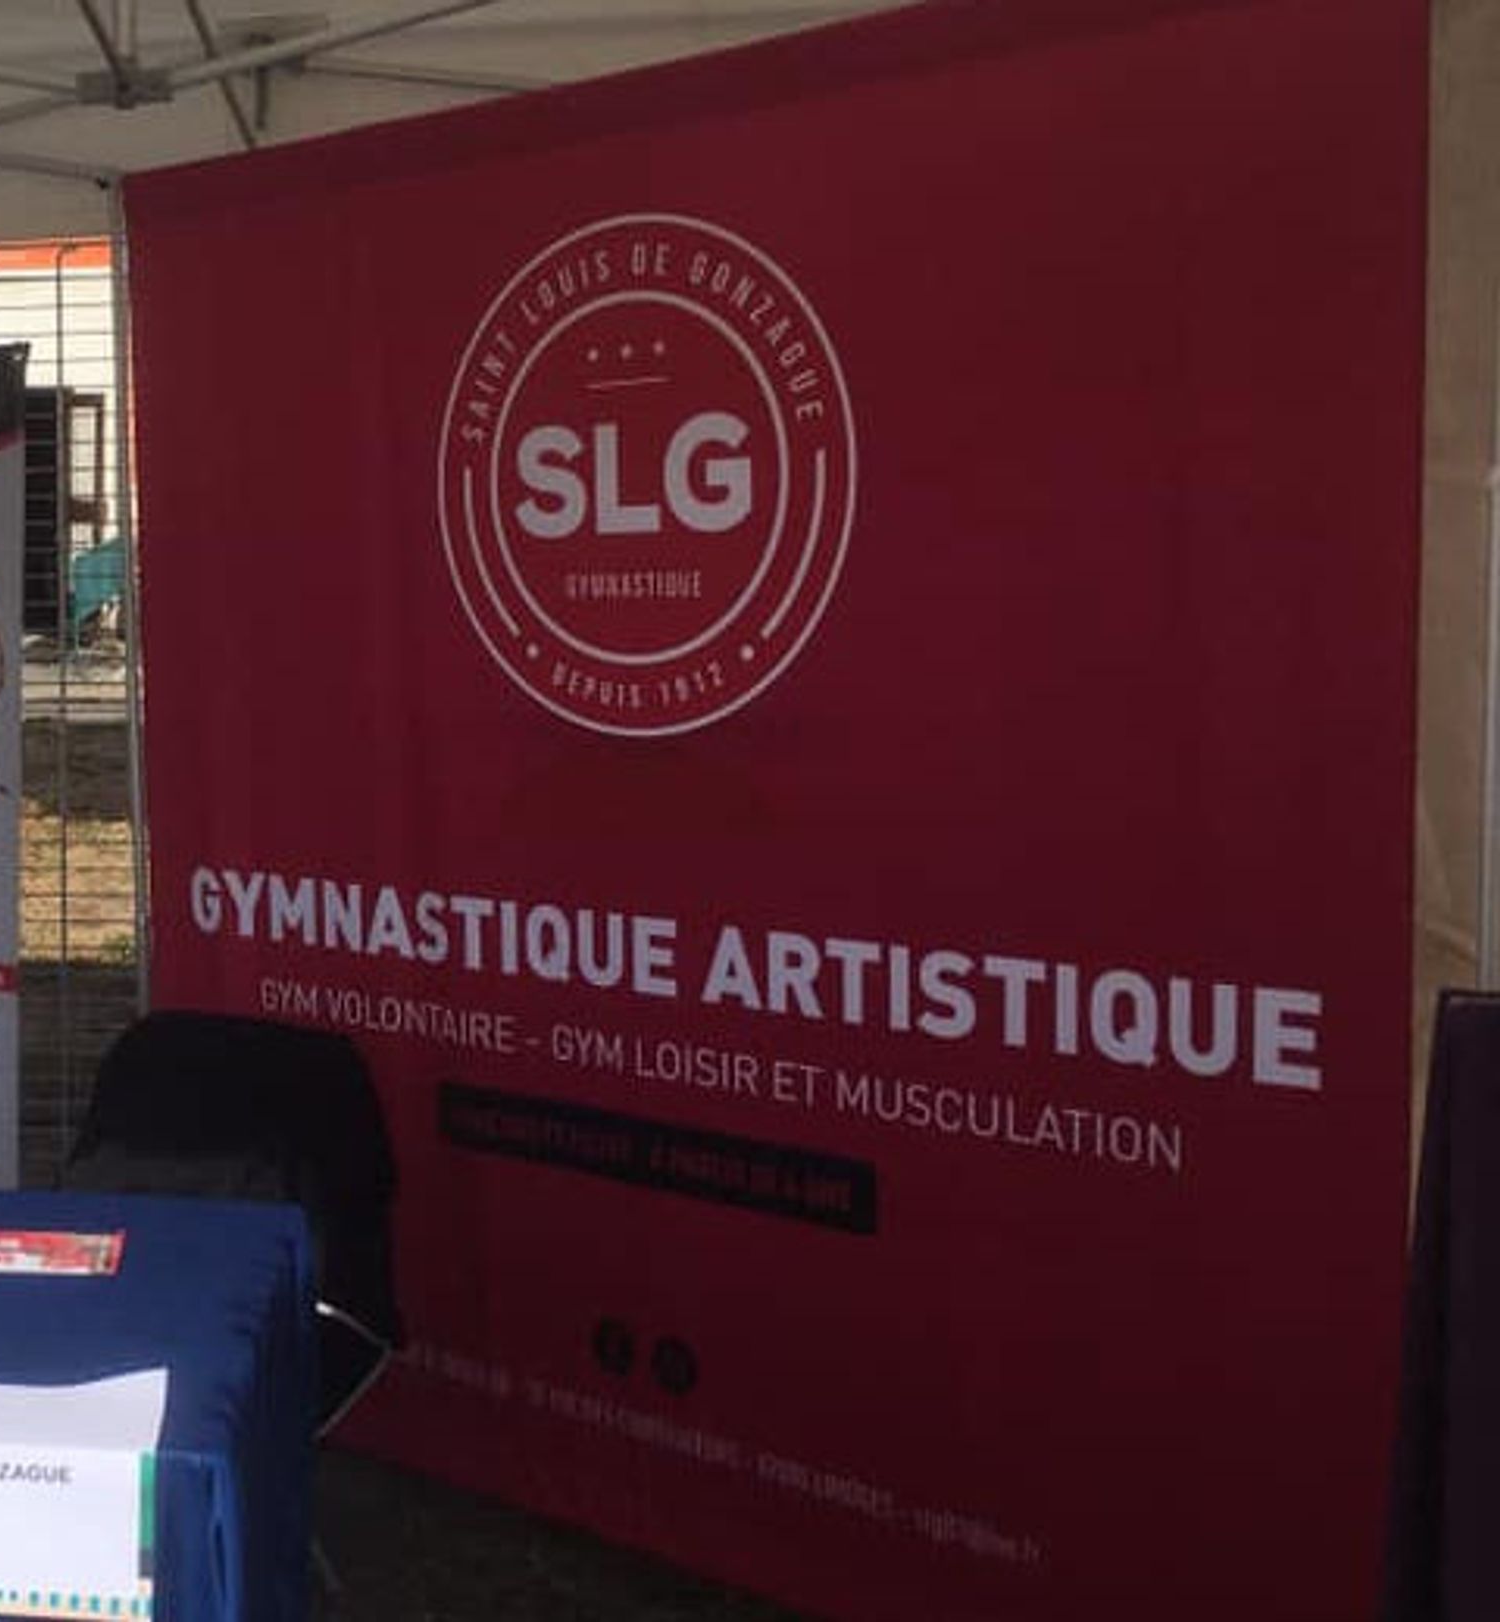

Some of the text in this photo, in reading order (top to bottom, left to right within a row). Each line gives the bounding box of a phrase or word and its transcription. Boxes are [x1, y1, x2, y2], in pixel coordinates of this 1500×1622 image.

[461, 243, 825, 446] SAINT LOUIS DE GONZAGUE
[514, 412, 753, 539] SLG
[565, 569, 703, 600] GYMNASTIQUE
[551, 661, 643, 709] DEPUIS
[190, 865, 1323, 1091] GYMNASTIQUE ARTISTIQUE
[260, 976, 319, 1014] GYM
[326, 988, 518, 1053] VOLONTAIRE
[551, 1024, 625, 1069] GYM
[635, 1037, 760, 1095] LOISIR
[773, 1061, 826, 1107] ET
[836, 1069, 1183, 1170] MUSCULATION
